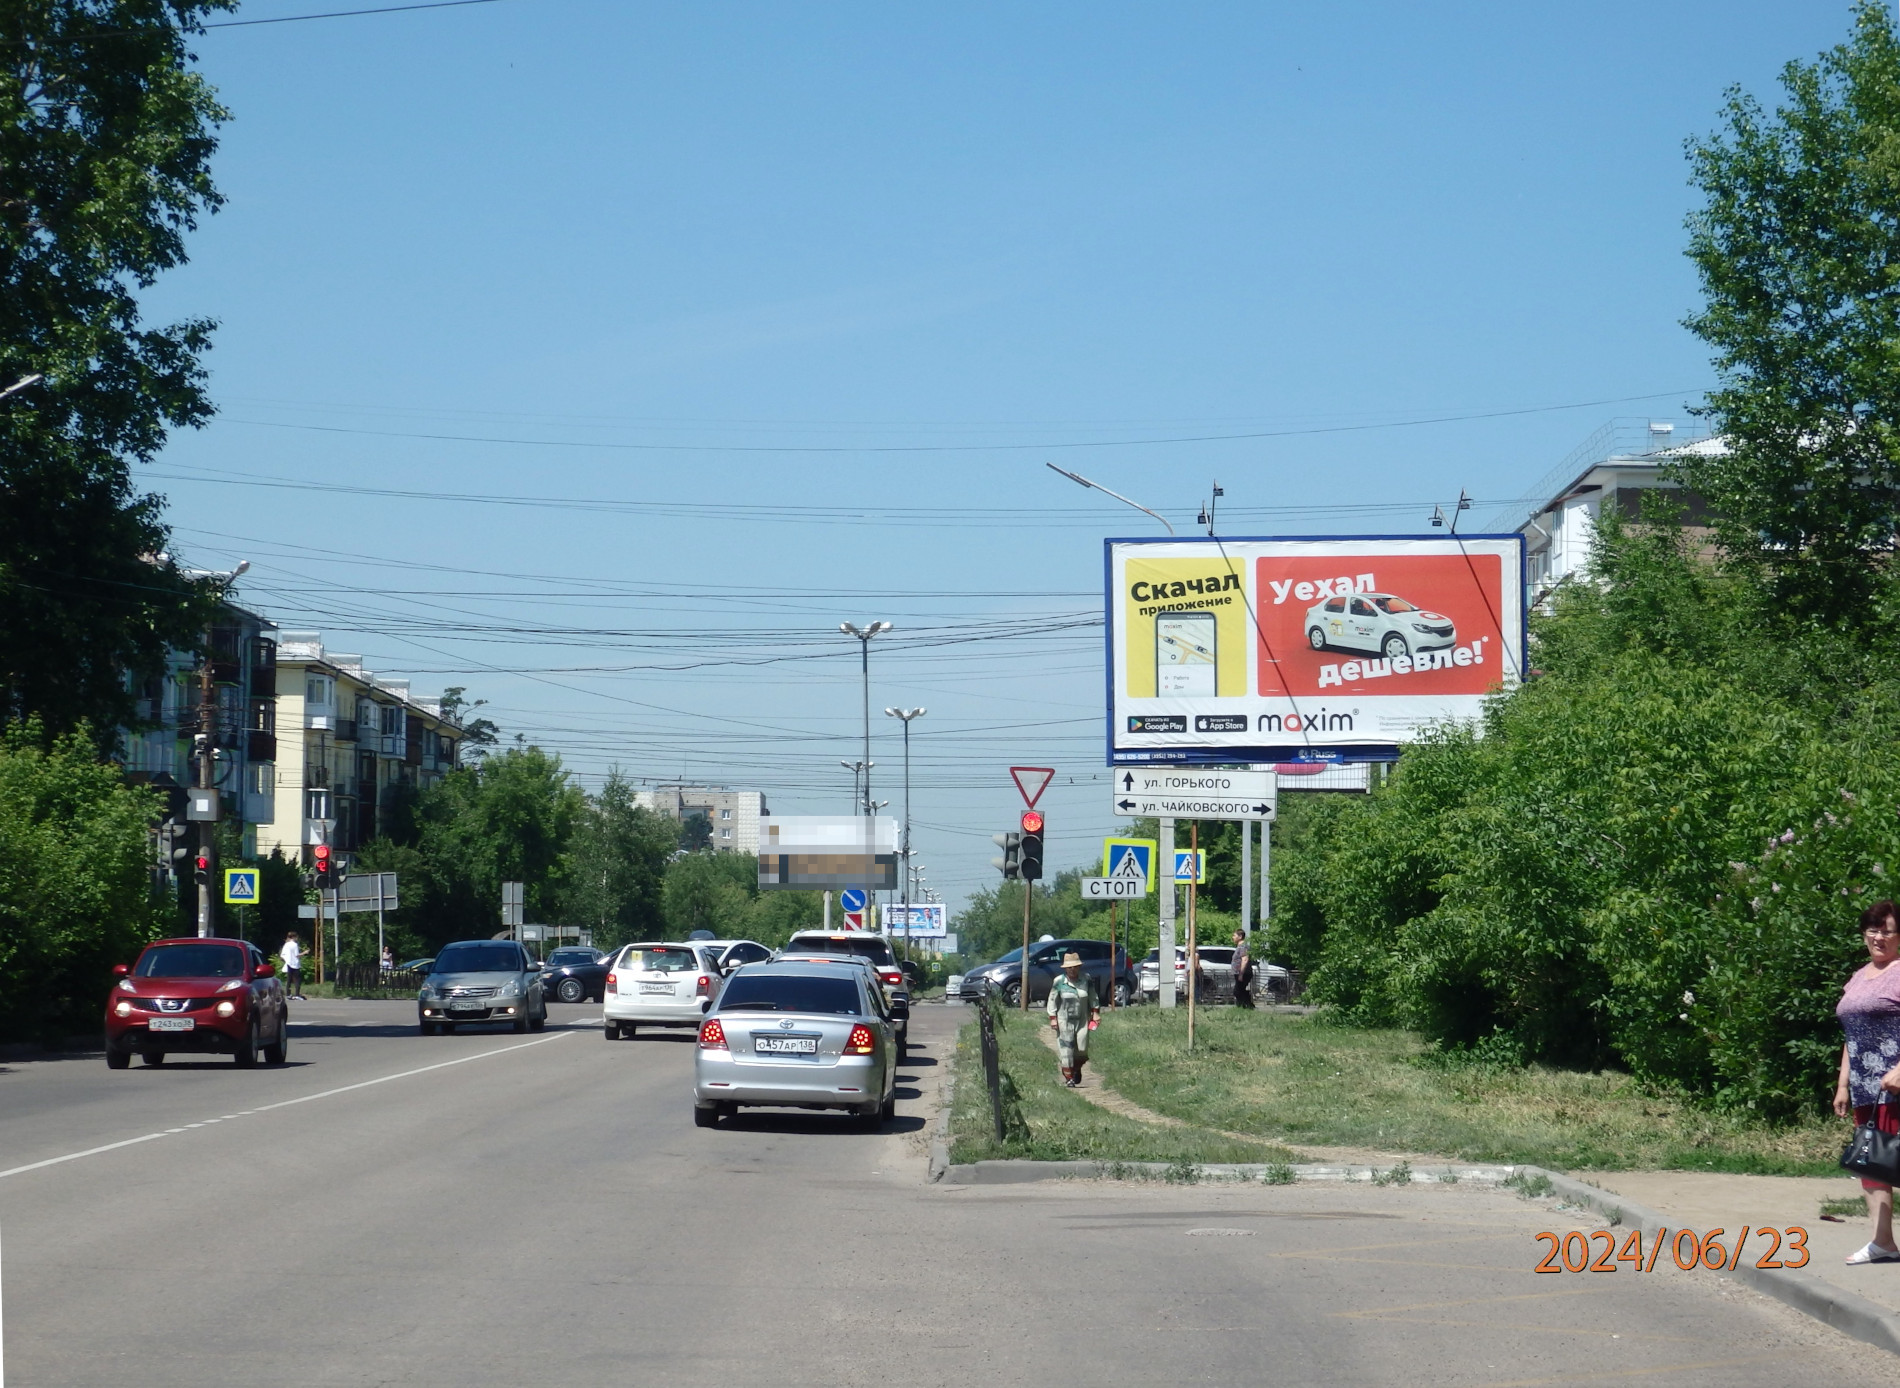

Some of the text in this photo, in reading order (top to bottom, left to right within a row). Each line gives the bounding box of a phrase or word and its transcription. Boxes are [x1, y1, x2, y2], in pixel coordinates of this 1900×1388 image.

[1131, 574, 1240, 602] Скачал
[1269, 573, 1375, 605] Уехал
[1139, 596, 1232, 617] приложение
[1144, 722, 1184, 731] Google Play
[1210, 722, 1244, 731] App Store
[1144, 778, 1231, 790] ул. ГОРЬКОГО
[1142, 801, 1249, 813] ул. ЧАЙКОВСКОГО
[1090, 881, 1137, 895] СТОП
